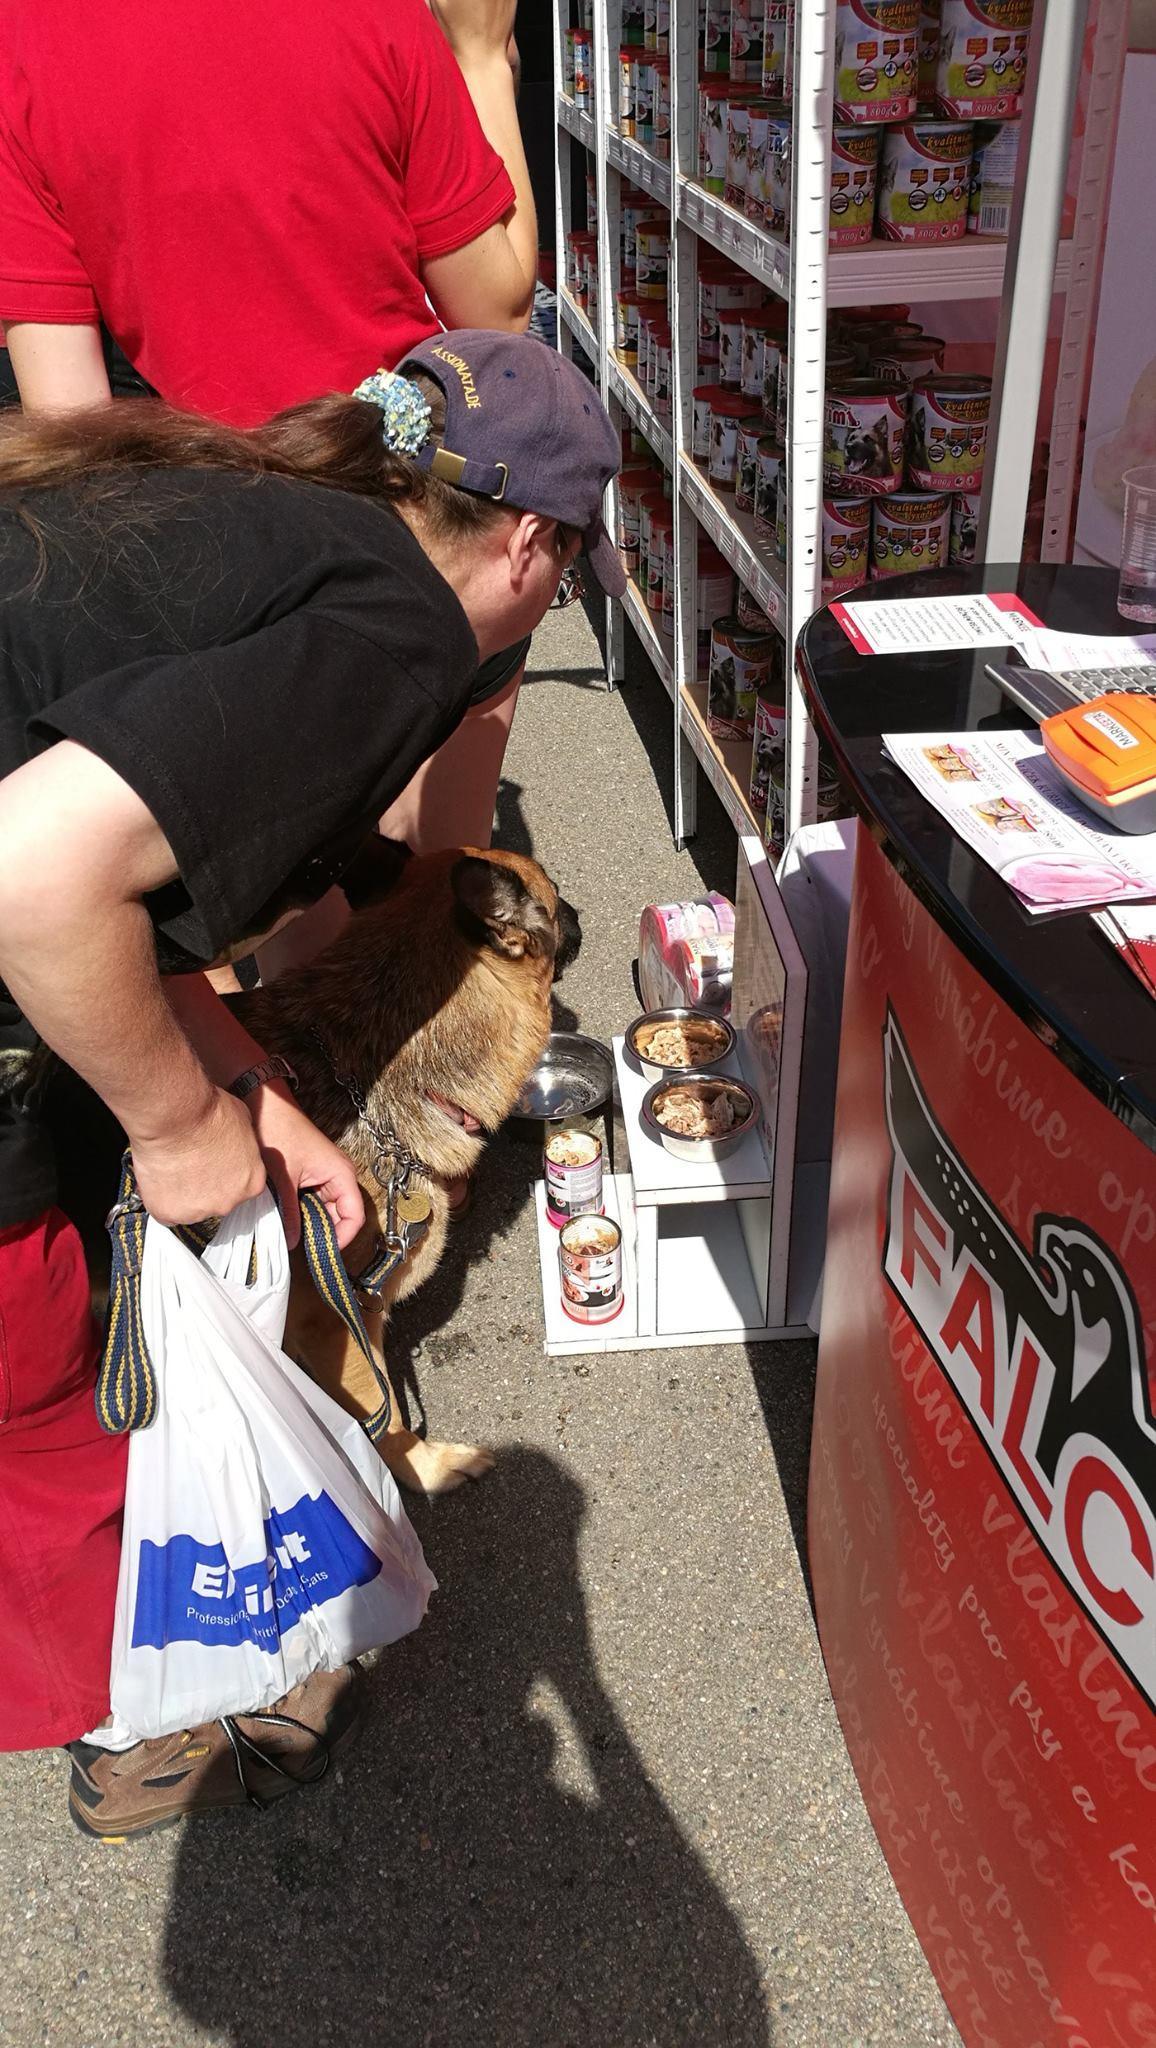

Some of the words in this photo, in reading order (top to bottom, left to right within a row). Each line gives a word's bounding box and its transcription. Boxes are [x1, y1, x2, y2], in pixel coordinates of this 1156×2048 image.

[958, 1584, 1007, 1661] pro
[1009, 1680, 1062, 1762] psy
[1071, 1785, 1098, 1822] a
